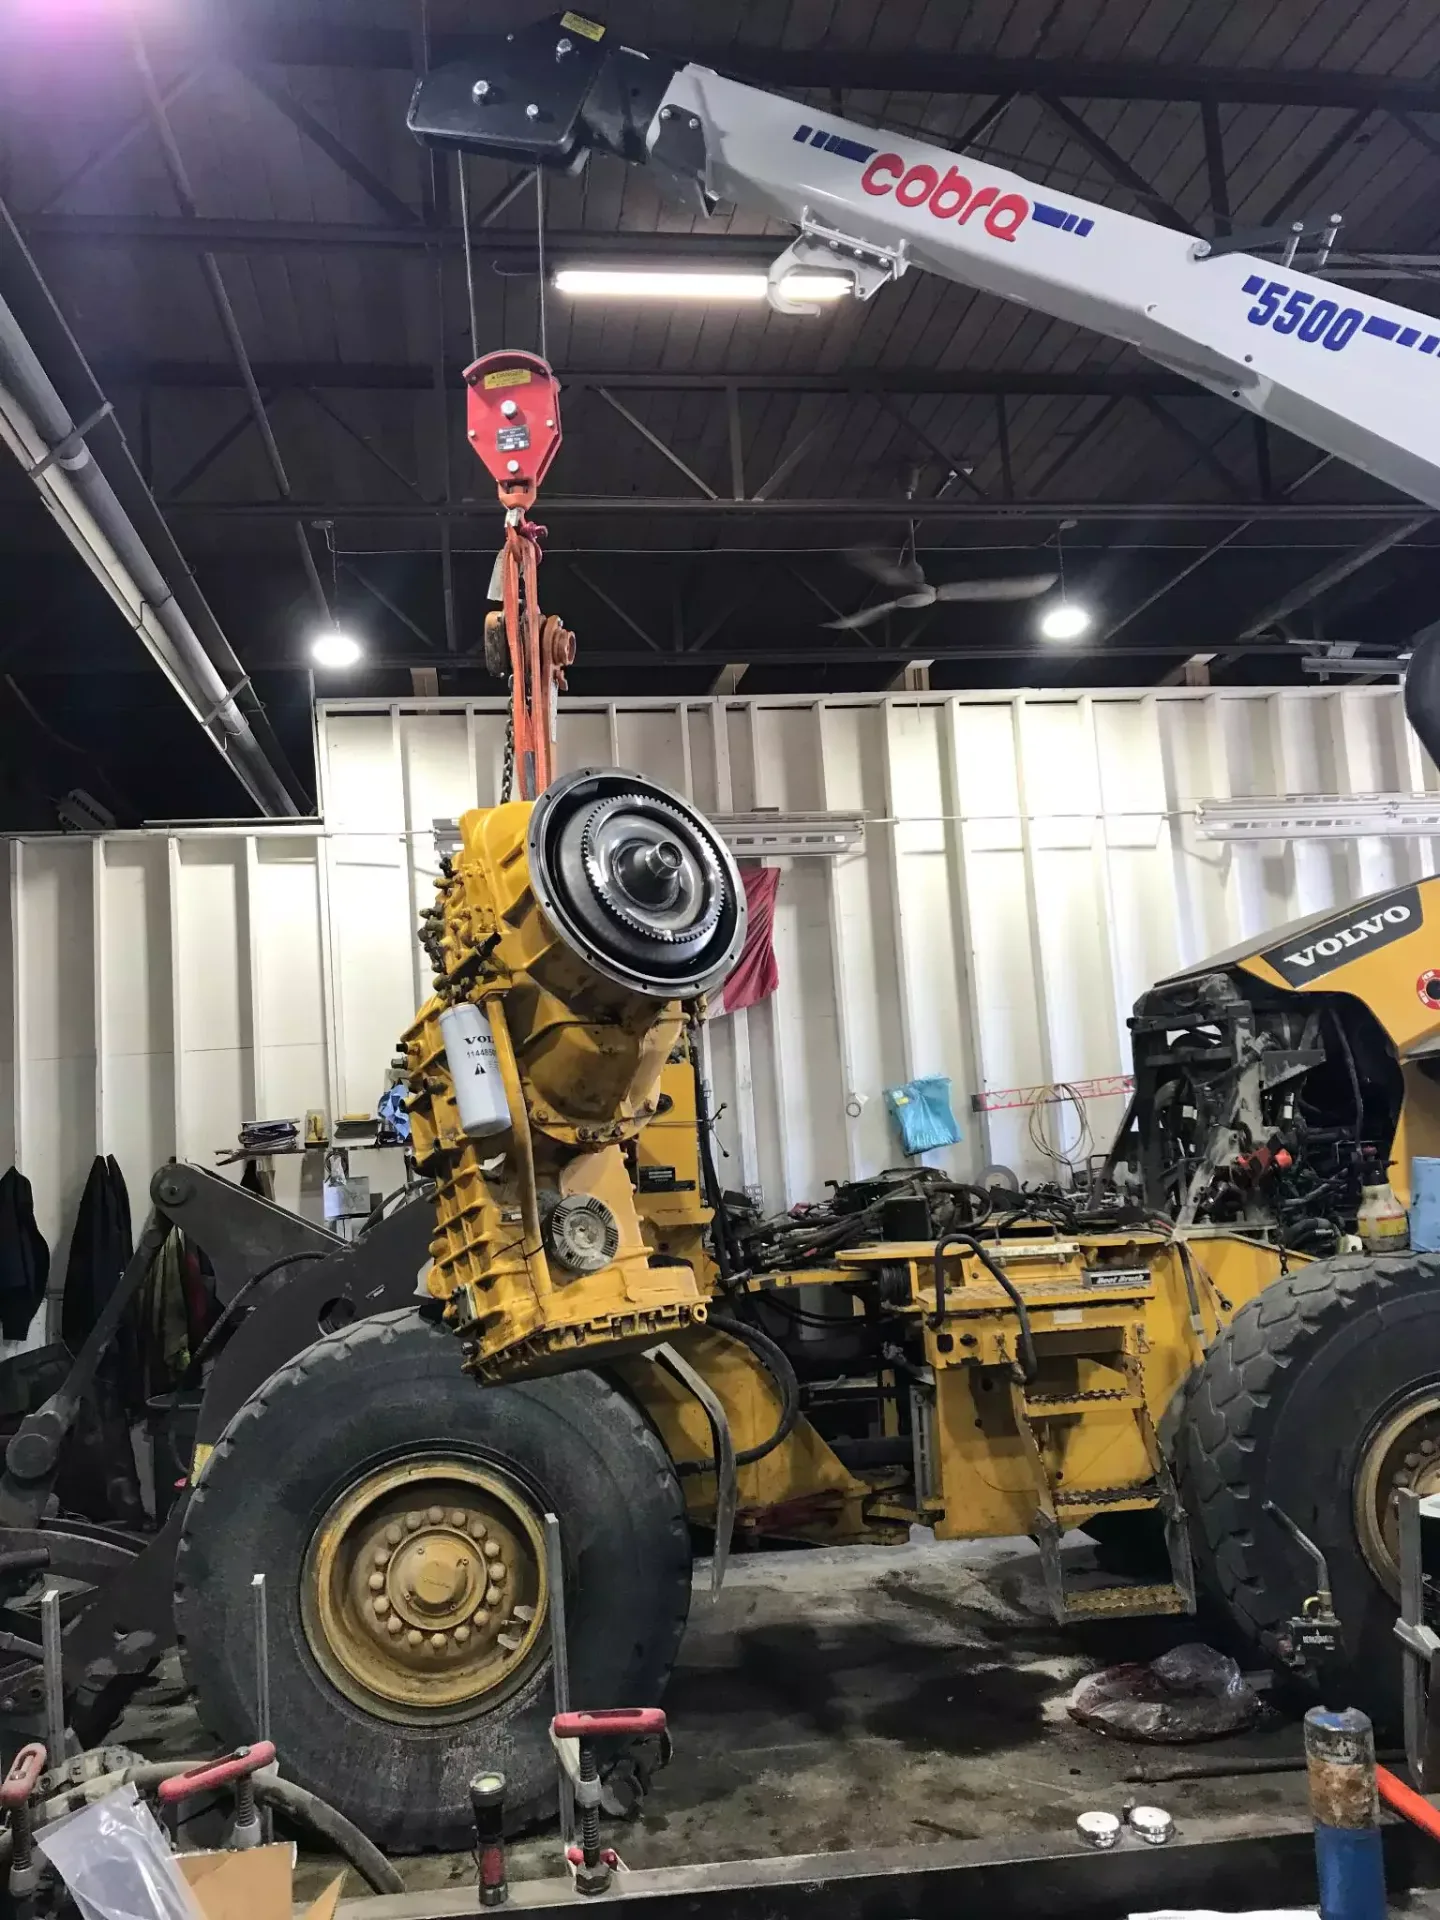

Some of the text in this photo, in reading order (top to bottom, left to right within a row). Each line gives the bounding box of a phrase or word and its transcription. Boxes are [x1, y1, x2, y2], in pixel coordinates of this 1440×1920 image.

[862, 153, 1029, 242] cobra
[1247, 281, 1364, 351] 5500
[1283, 905, 1411, 967] VOLVO
